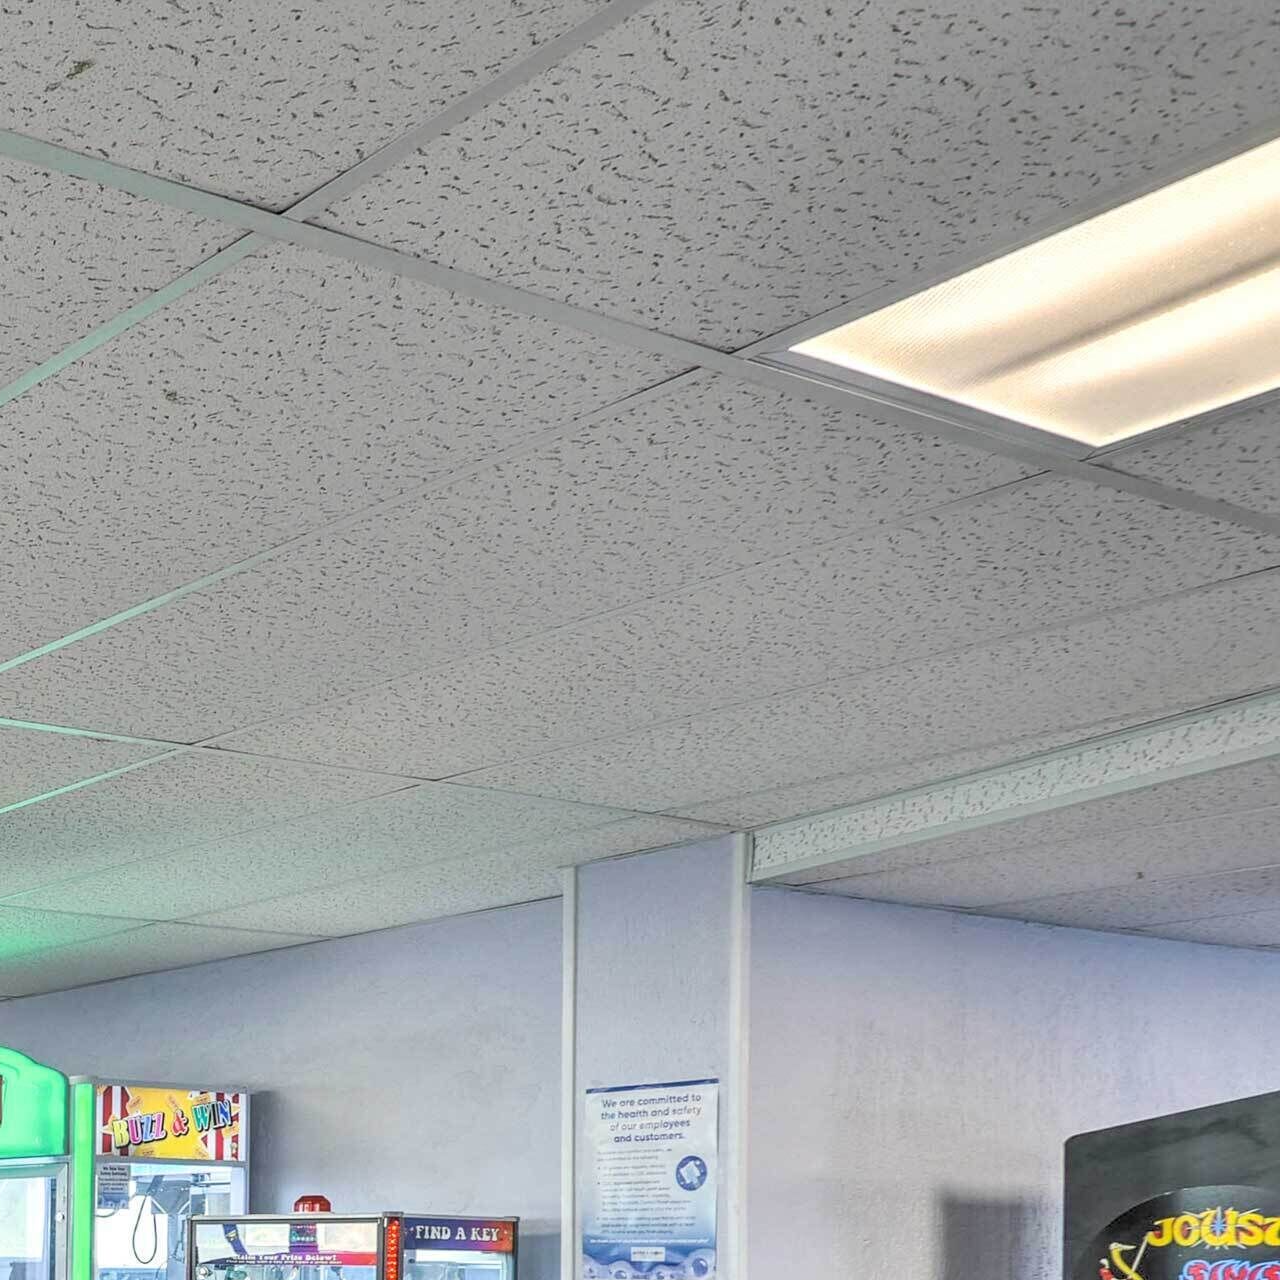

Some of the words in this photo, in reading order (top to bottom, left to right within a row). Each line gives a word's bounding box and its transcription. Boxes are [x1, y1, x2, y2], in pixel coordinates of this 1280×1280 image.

[602, 1099, 617, 1108] We
[620, 1099, 635, 1107] are
[638, 1094, 689, 1106] committed
[601, 1111, 616, 1120] the
[618, 1109, 648, 1119] health
[651, 1107, 669, 1117] and
[672, 1106, 702, 1116] safety
[112, 1112, 167, 1148] BUZZ
[171, 1108, 189, 1137] &
[192, 1100, 233, 1132] WIN
[621, 1123, 637, 1131] our
[639, 1119, 690, 1131] employees
[614, 1134, 632, 1143] and
[415, 1225, 451, 1240] FIND
[455, 1227, 466, 1240] A
[470, 1227, 499, 1241] KEY
